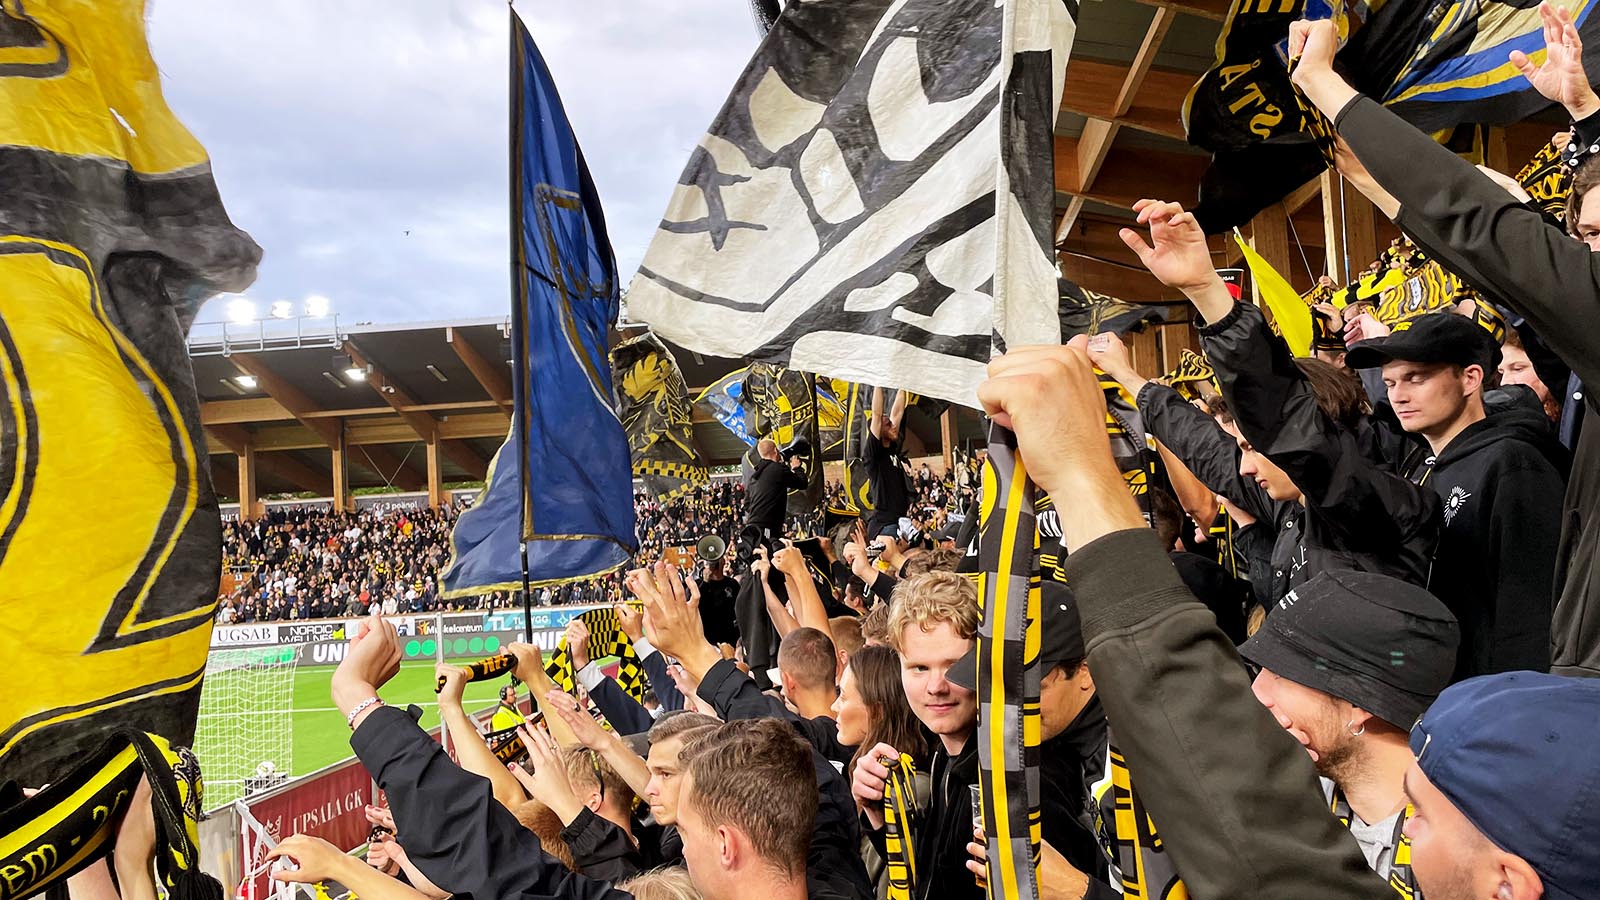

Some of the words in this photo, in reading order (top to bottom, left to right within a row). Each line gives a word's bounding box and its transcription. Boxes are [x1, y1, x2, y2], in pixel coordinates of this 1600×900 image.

[217, 628, 271, 642] UGSAB
[289, 624, 333, 635] NORDIC
[427, 622, 483, 635] Mukelcentrum
[312, 643, 350, 663] UNI
[292, 798, 342, 835] UPSALA
[345, 788, 363, 812] GK
